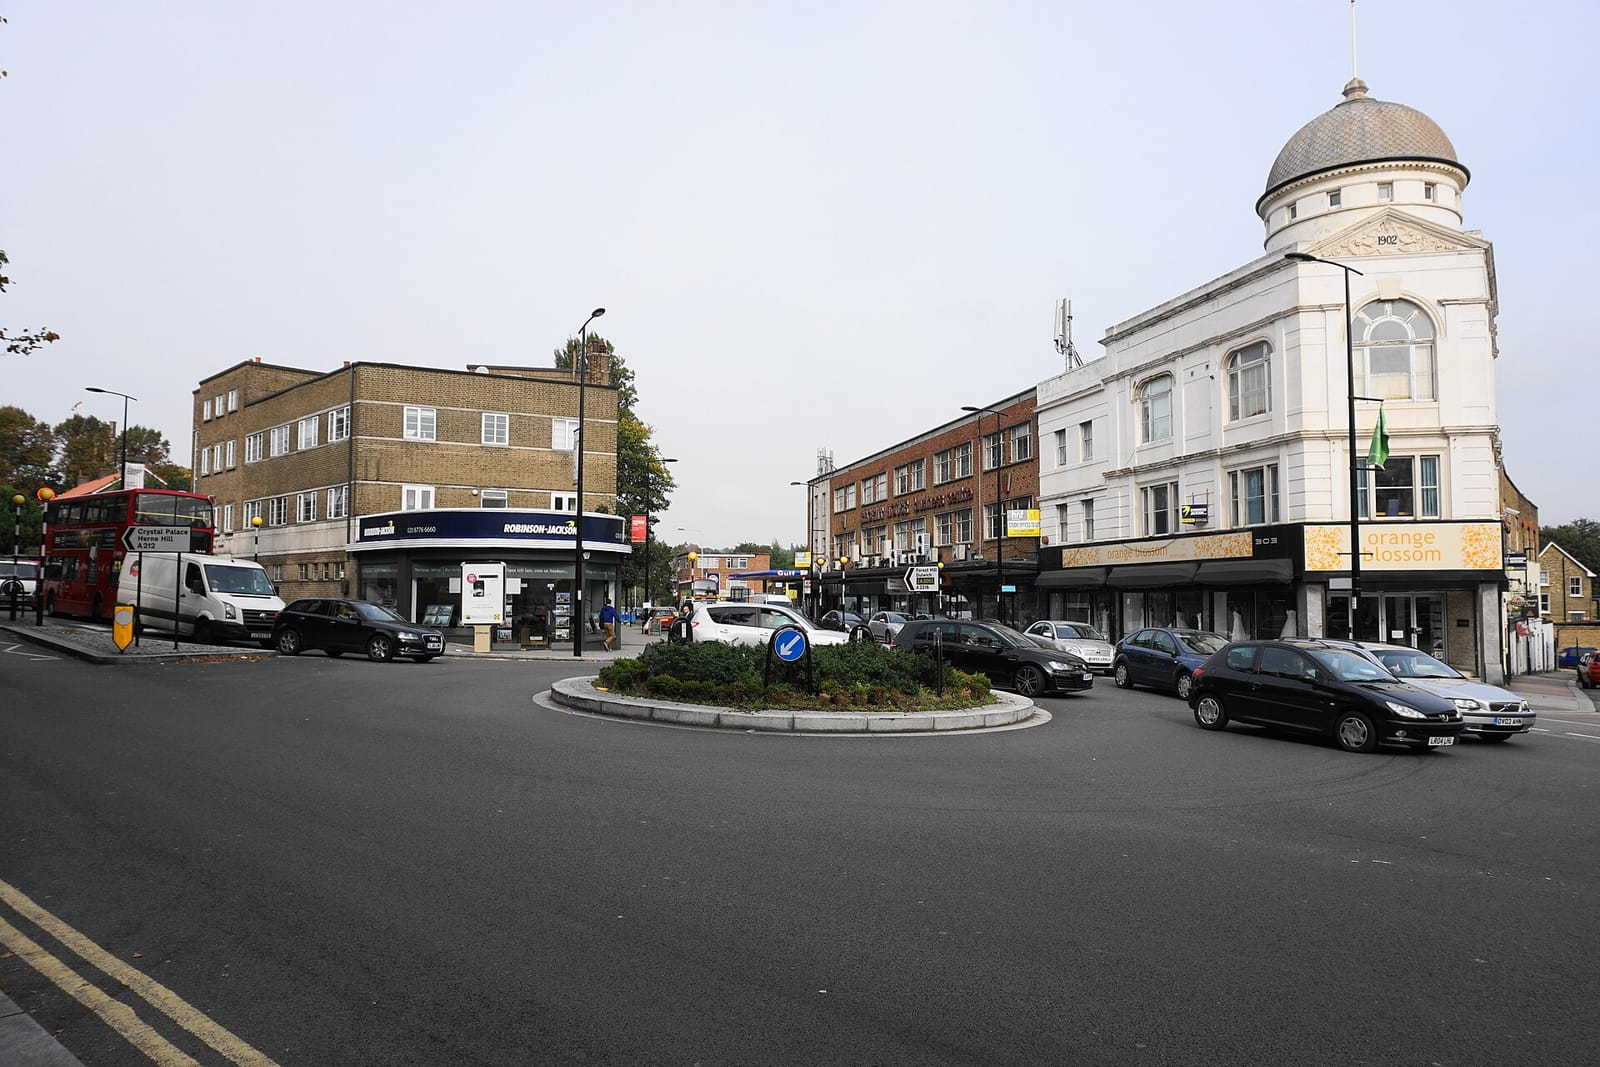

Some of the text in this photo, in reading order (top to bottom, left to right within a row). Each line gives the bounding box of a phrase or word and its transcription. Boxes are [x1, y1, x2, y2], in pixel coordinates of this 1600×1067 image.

[1377, 235, 1397, 246] 1902
[503, 523, 577, 535] ROBINSON-JACKSON
[1367, 532, 1436, 549] orange
[1107, 544, 1168, 561] orange blossom
[1363, 546, 1441, 562] blossom
